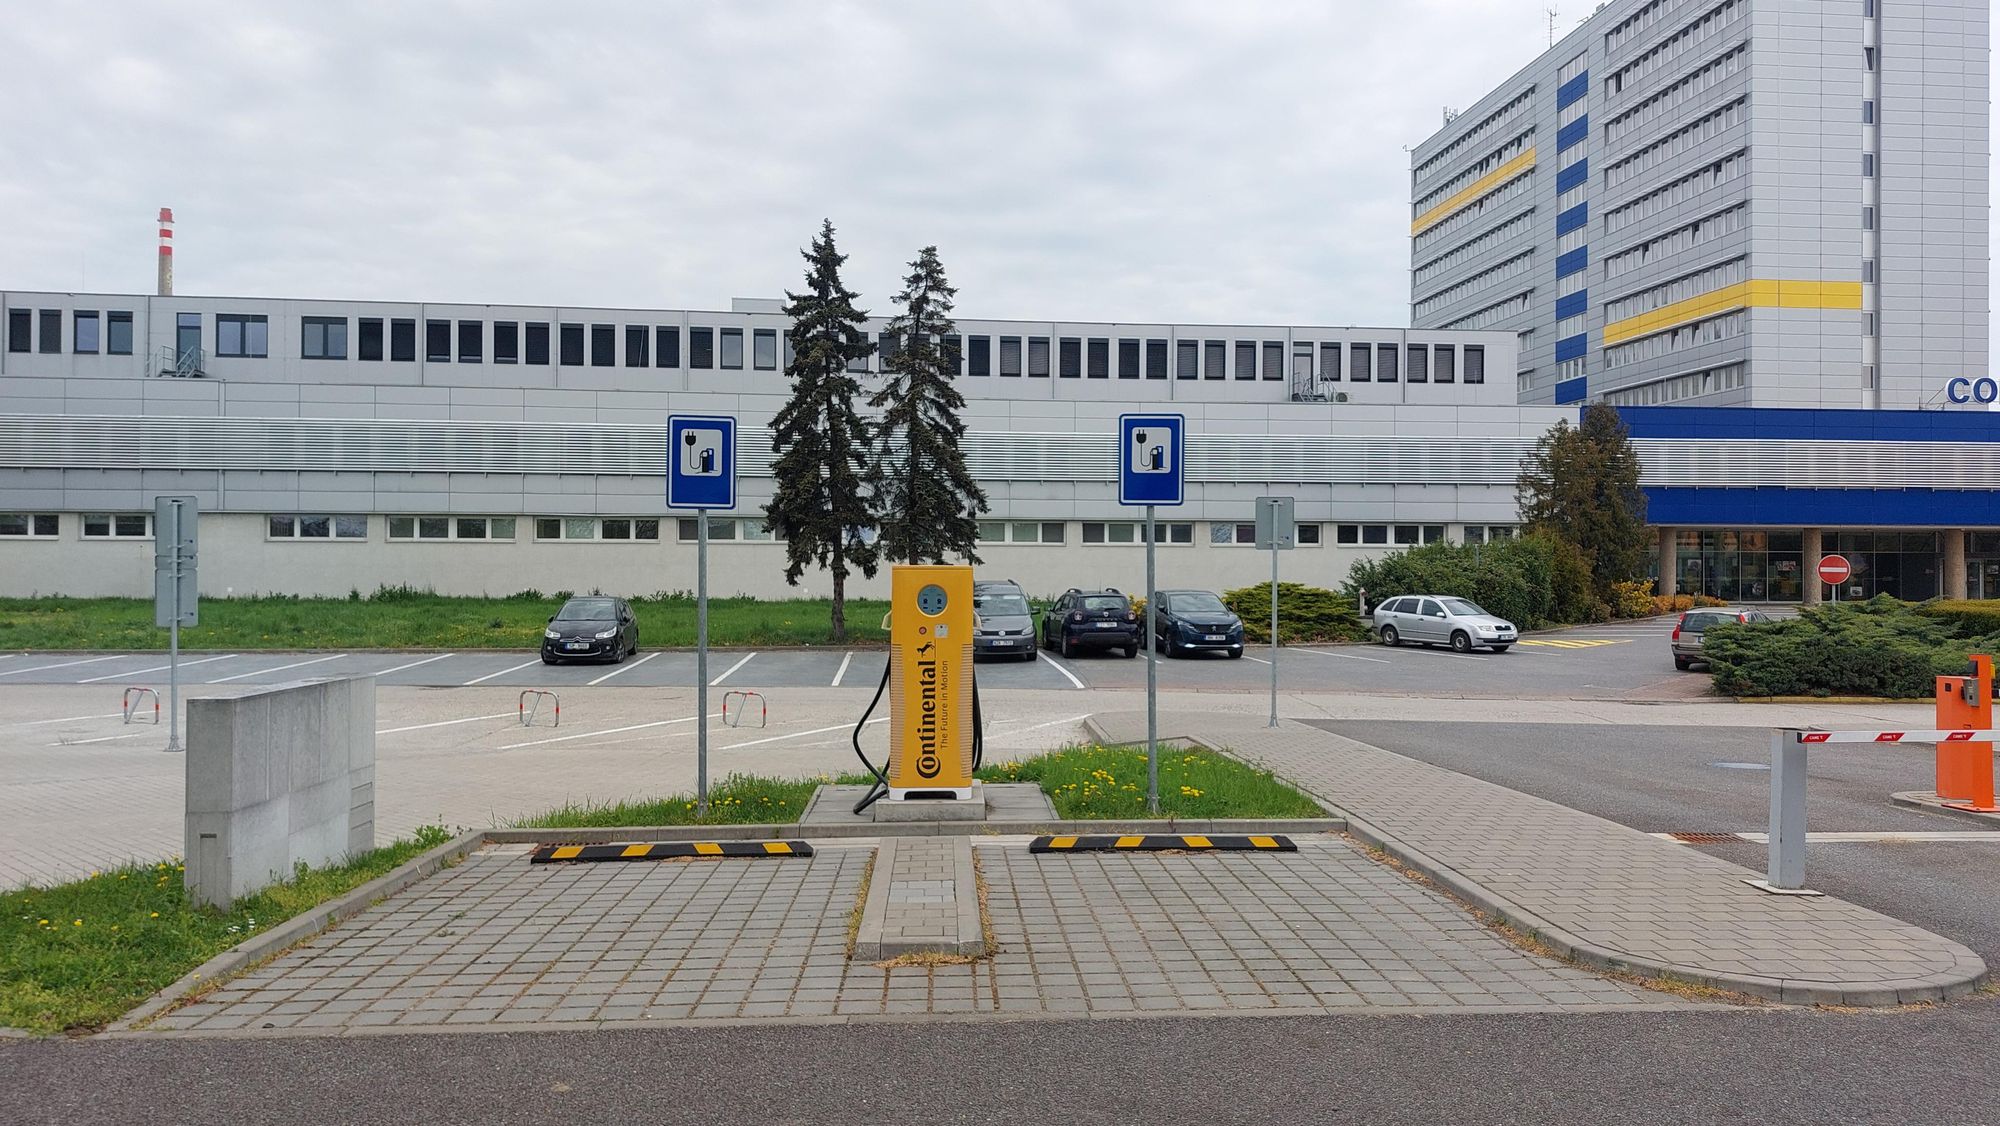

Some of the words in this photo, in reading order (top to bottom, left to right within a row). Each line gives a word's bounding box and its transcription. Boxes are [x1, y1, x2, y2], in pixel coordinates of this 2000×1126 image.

[1947, 377, 1998, 404] CO
[940, 660, 948, 690] Motion
[916, 660, 941, 779] Continental
[940, 705, 948, 730] Future
[940, 733, 948, 749] The
